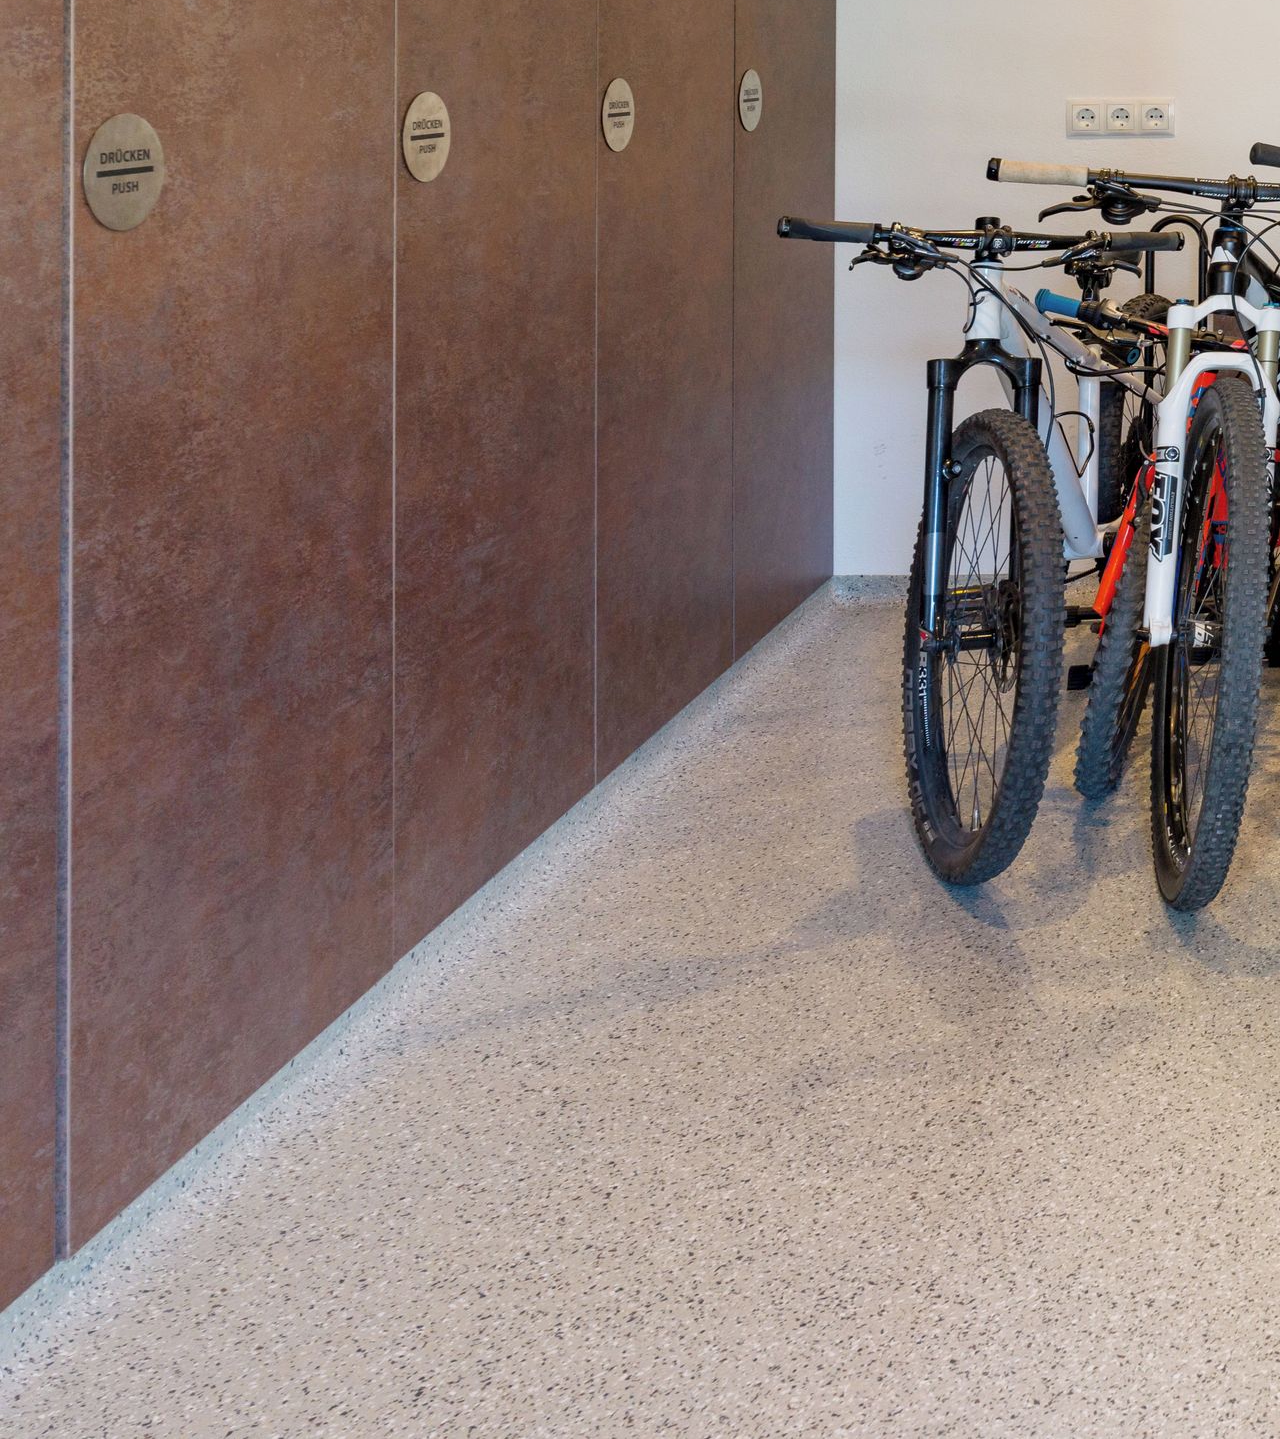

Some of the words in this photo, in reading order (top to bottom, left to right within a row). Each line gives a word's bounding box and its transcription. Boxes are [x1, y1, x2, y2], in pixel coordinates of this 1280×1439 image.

[412, 118, 443, 131] DRÜCKEN
[419, 144, 436, 154] PUSH
[99, 148, 151, 165] DRÜCKEN
[111, 181, 139, 195] PUSH
